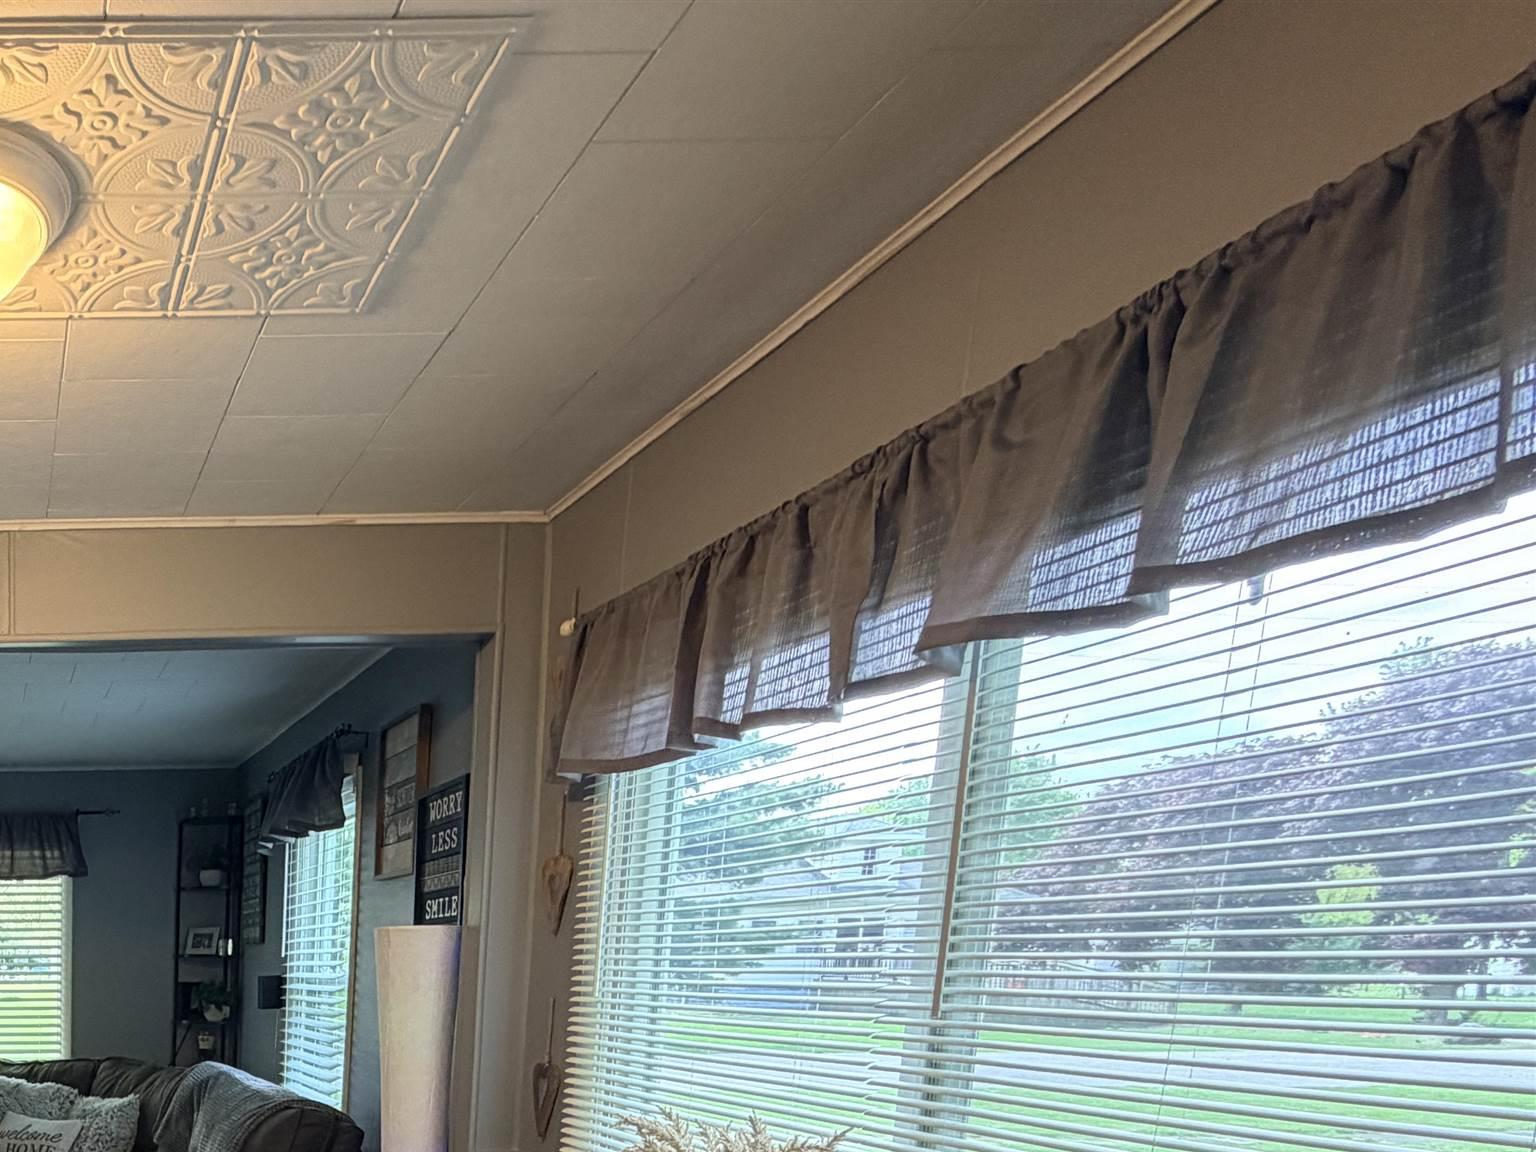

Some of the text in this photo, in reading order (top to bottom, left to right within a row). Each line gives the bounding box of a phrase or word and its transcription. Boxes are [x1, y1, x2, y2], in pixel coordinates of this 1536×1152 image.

[429, 791, 463, 823] WORRY
[431, 827, 458, 854] LESS
[425, 895, 459, 920] SMILE
